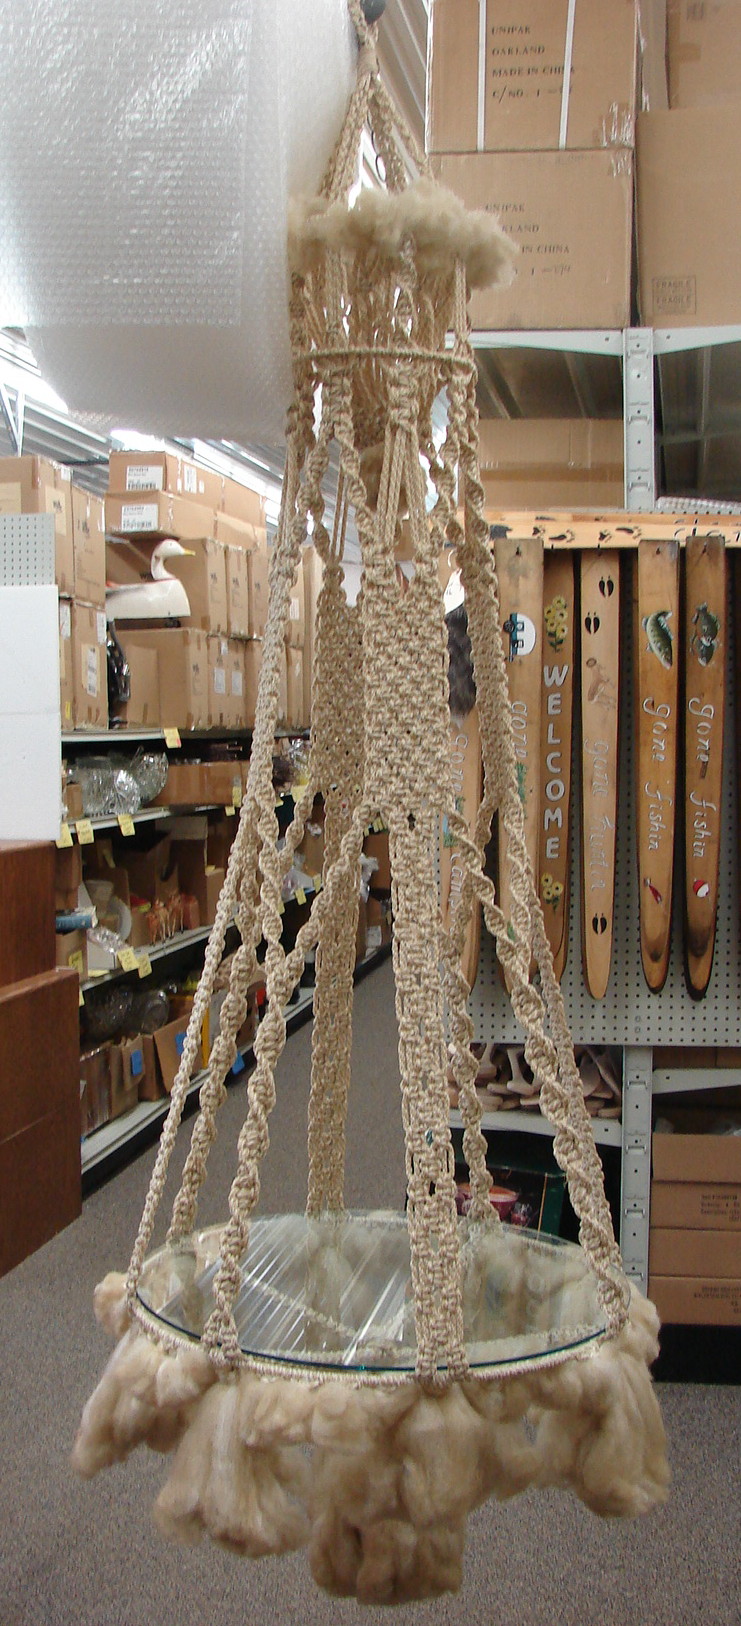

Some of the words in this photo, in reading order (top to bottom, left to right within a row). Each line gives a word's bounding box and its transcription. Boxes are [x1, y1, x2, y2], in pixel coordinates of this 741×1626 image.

[491, 45, 545, 56] OAKLAND
[492, 67, 523, 77] MADE
[527, 66, 539, 75] IN
[501, 224, 540, 233] KLAND
[537, 244, 570, 254] CHINA
[643, 696, 671, 762] gone
[688, 697, 715, 763] gone
[542, 664, 570, 859] WELCOME
[584, 737, 609, 797] gone
[643, 782, 673, 851] fishin
[689, 791, 717, 858] fishin
